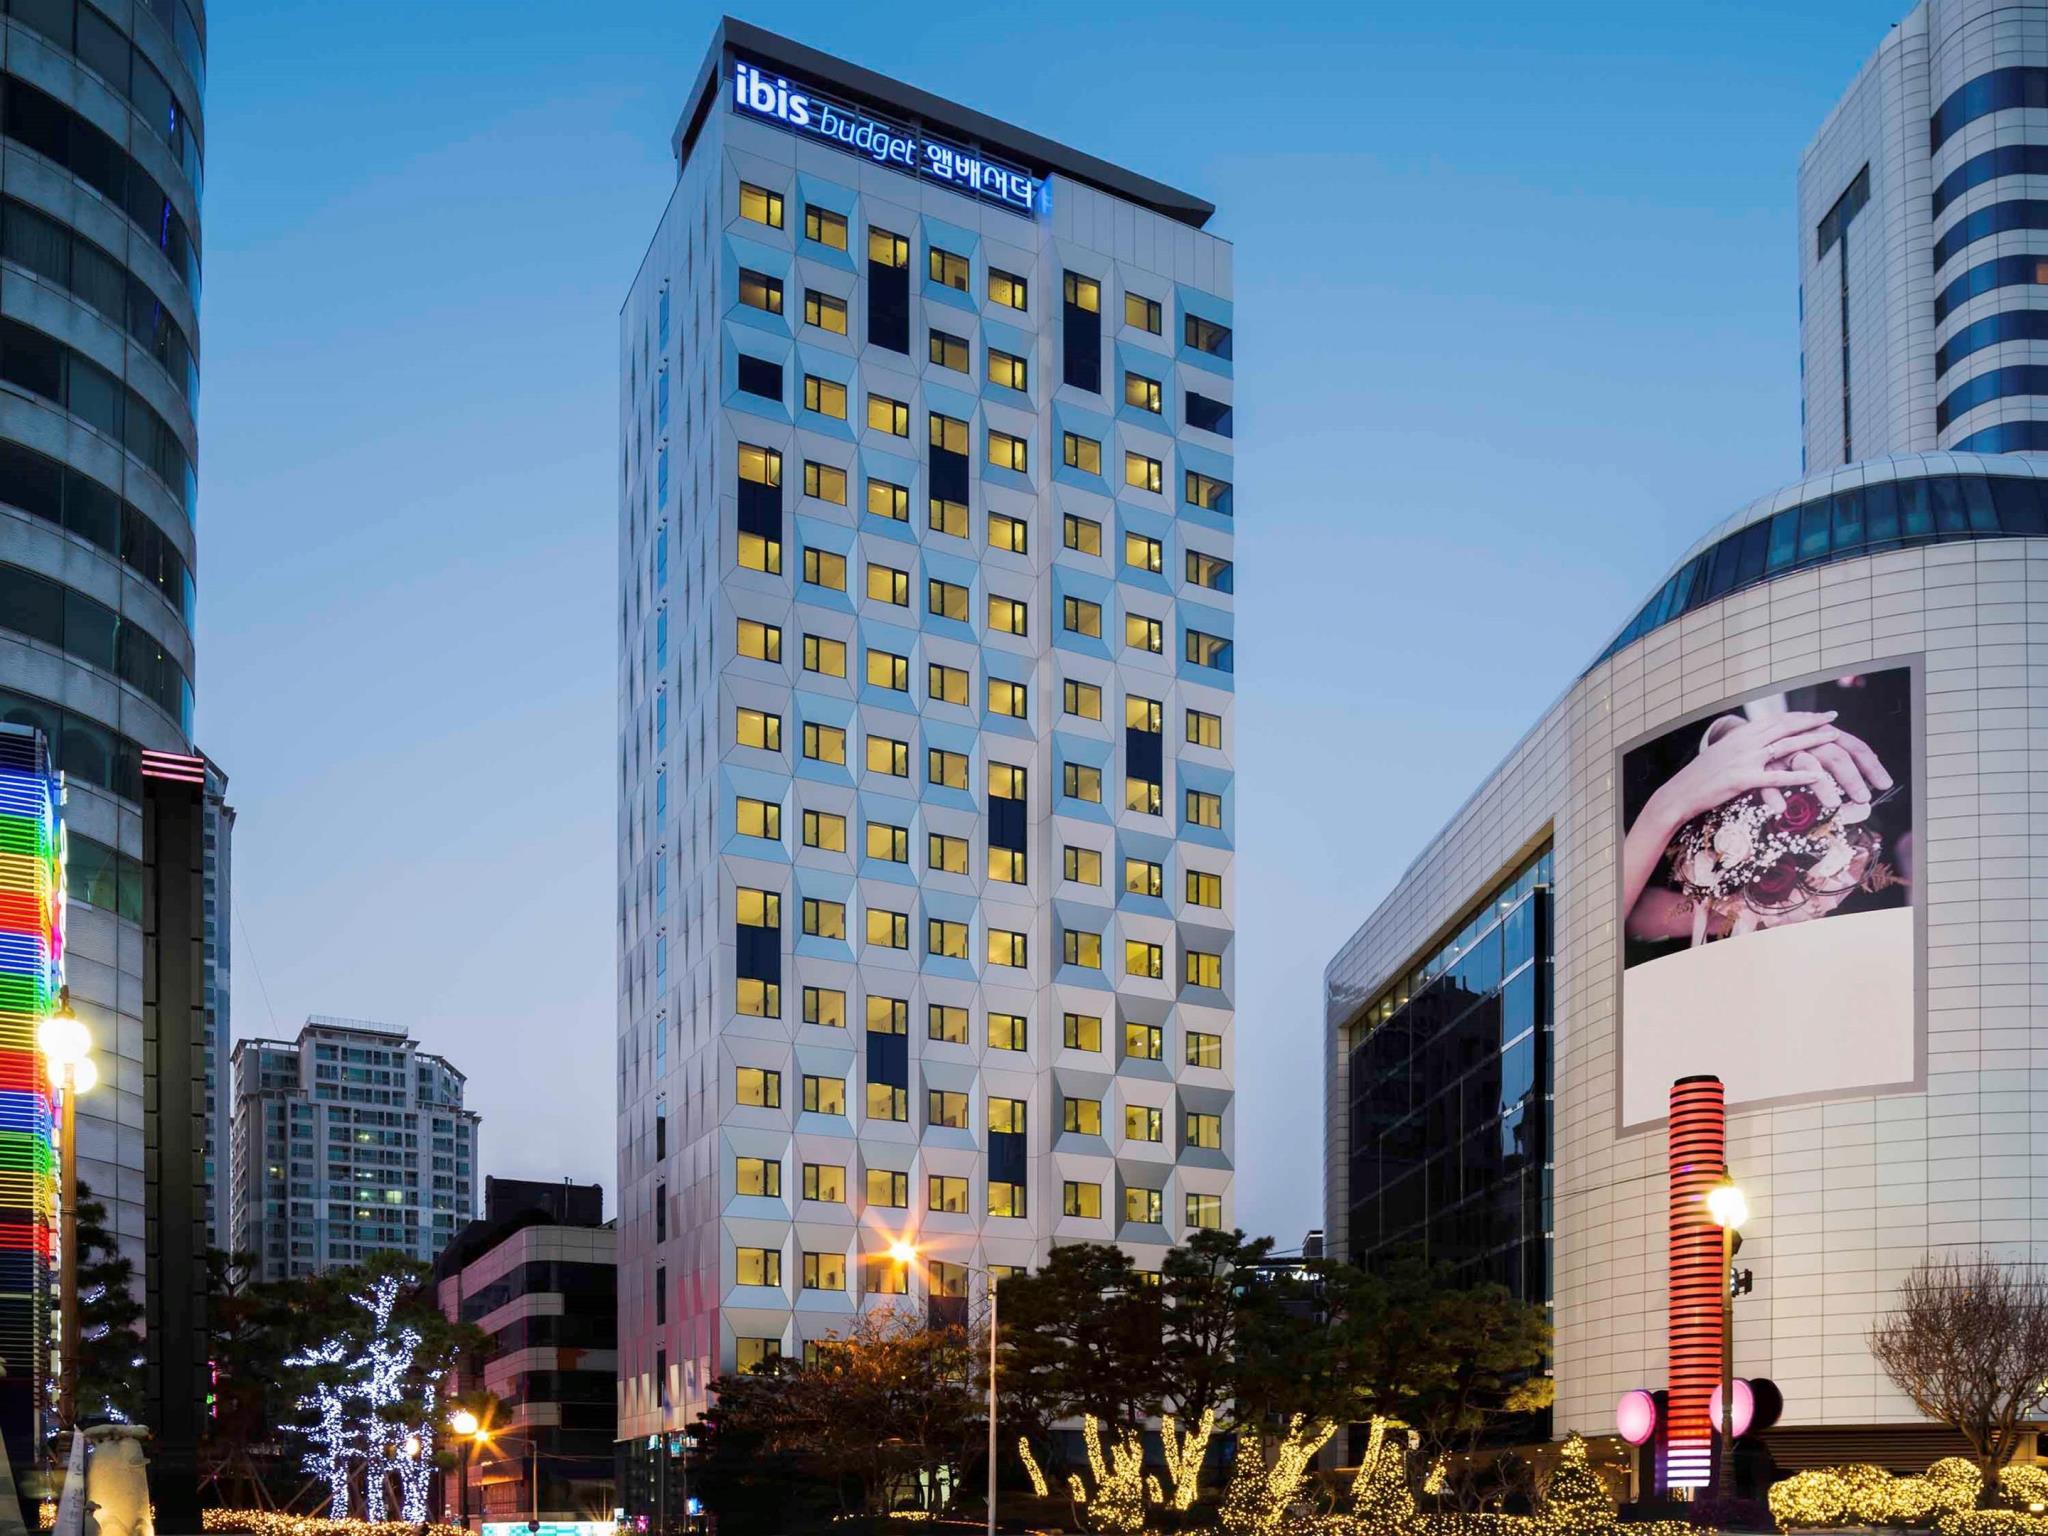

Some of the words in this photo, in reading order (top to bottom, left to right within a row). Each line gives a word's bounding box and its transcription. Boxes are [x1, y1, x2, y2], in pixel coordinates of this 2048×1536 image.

[737, 63, 810, 126] ibis
[820, 106, 917, 164] budget
[927, 144, 1032, 208] 앰배서더
